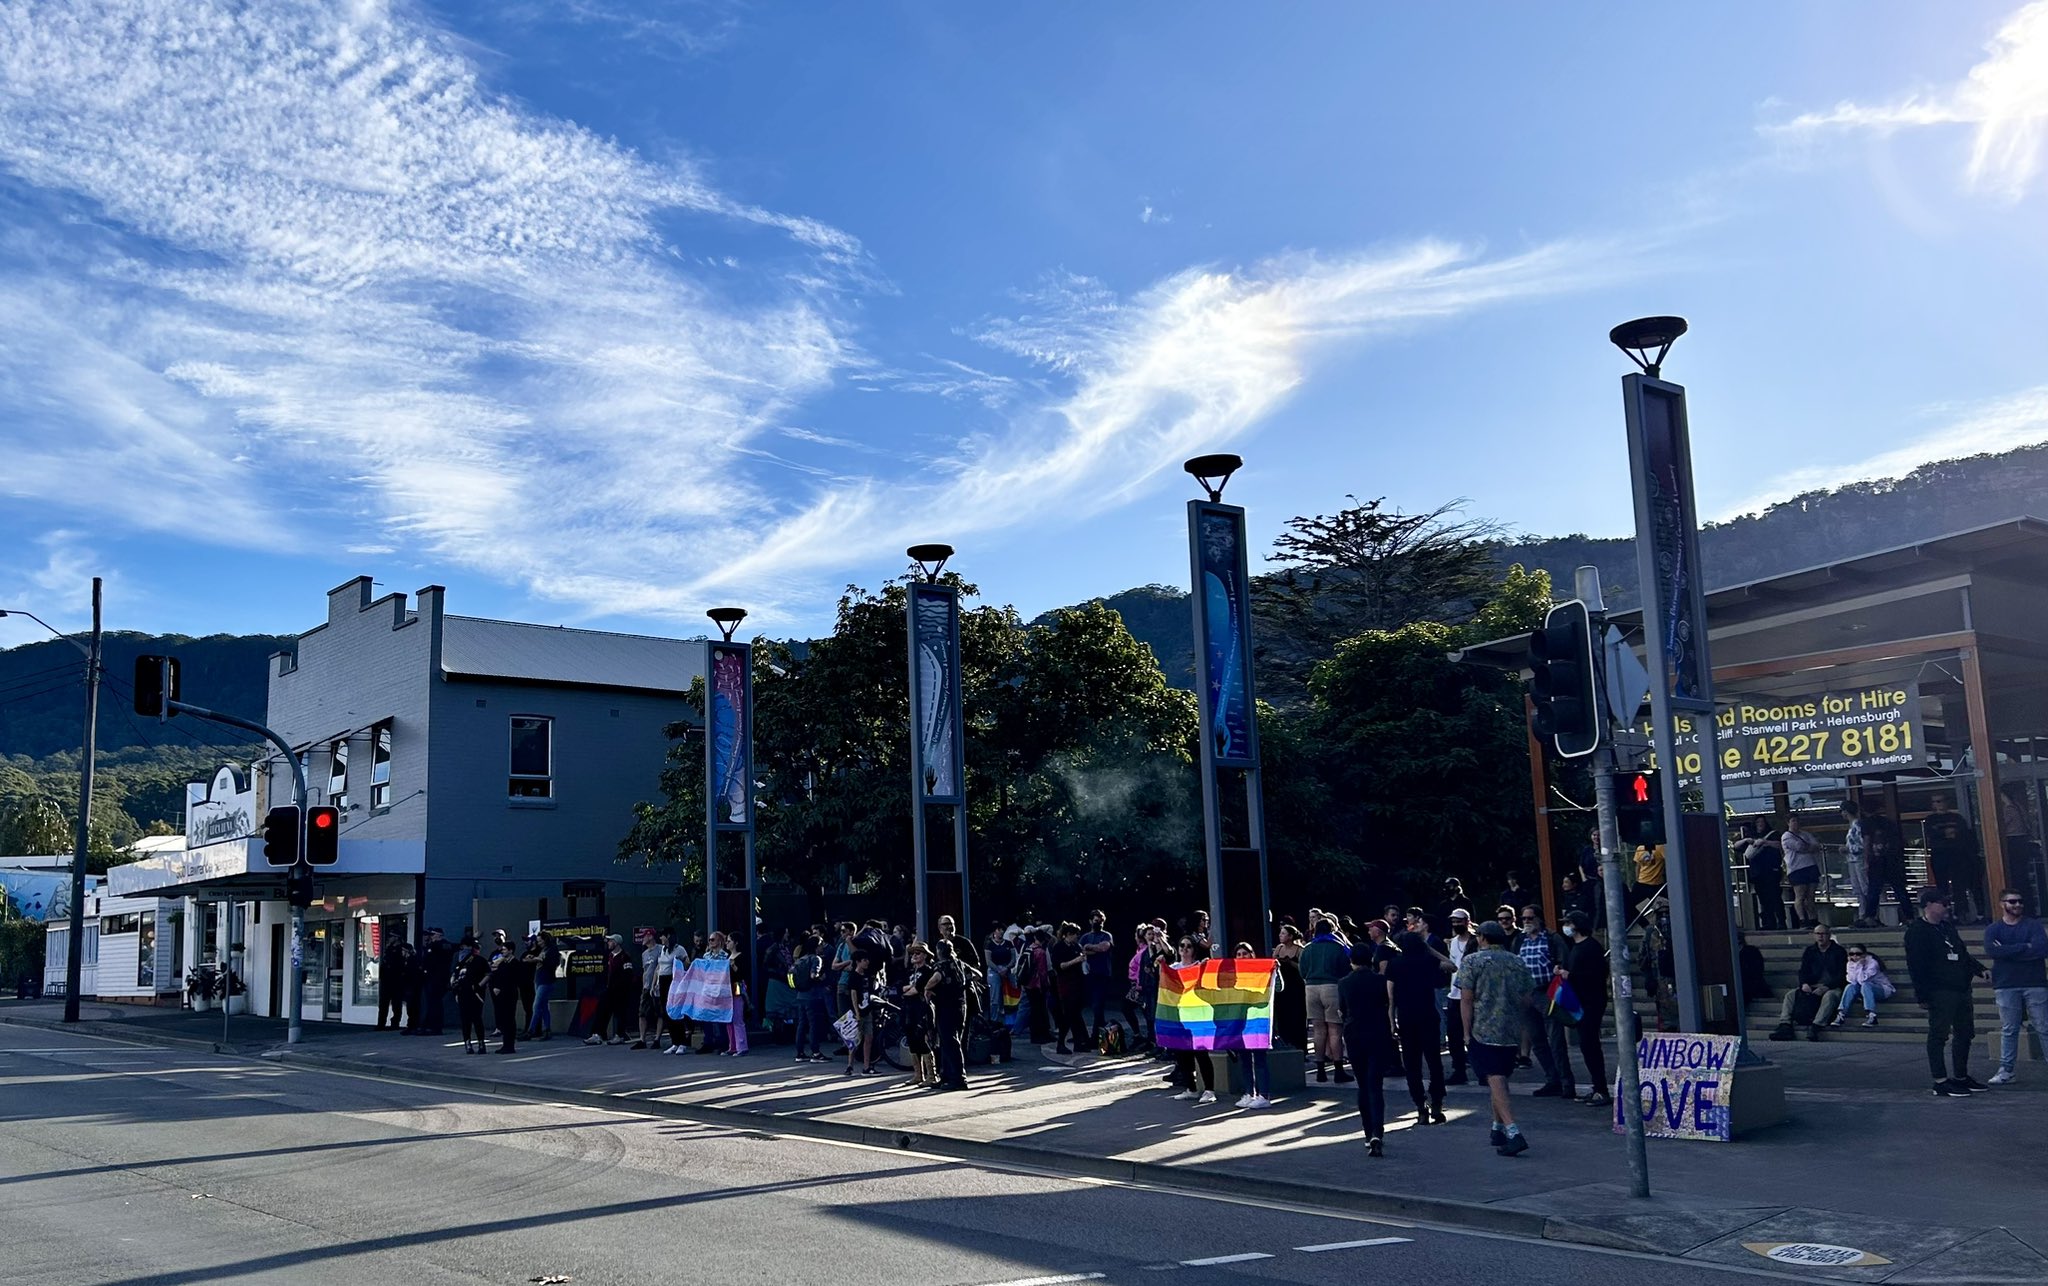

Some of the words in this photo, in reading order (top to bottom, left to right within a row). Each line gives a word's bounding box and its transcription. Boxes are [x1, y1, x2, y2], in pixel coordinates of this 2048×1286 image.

[1644, 716, 1691, 737] Hls
[1716, 708, 1734, 727] nd
[1741, 702, 1816, 724] Rooms
[1822, 696, 1853, 714] for
[1860, 689, 1906, 709] Hire
[1693, 728, 1733, 743] Ccliff
[1742, 722, 1788, 736] Stanwell
[1792, 719, 1818, 731] Park
[1827, 708, 1900, 726] Helensburgh
[1753, 731, 1829, 764] 4227
[1842, 721, 1912, 757] 8181
[1696, 771, 1751, 784] Eements
[1759, 765, 1798, 776] Birthdays
[1804, 760, 1863, 772] Conferences
[1871, 754, 1912, 766] Meetings
[1637, 1037, 1731, 1070] AINBOW
